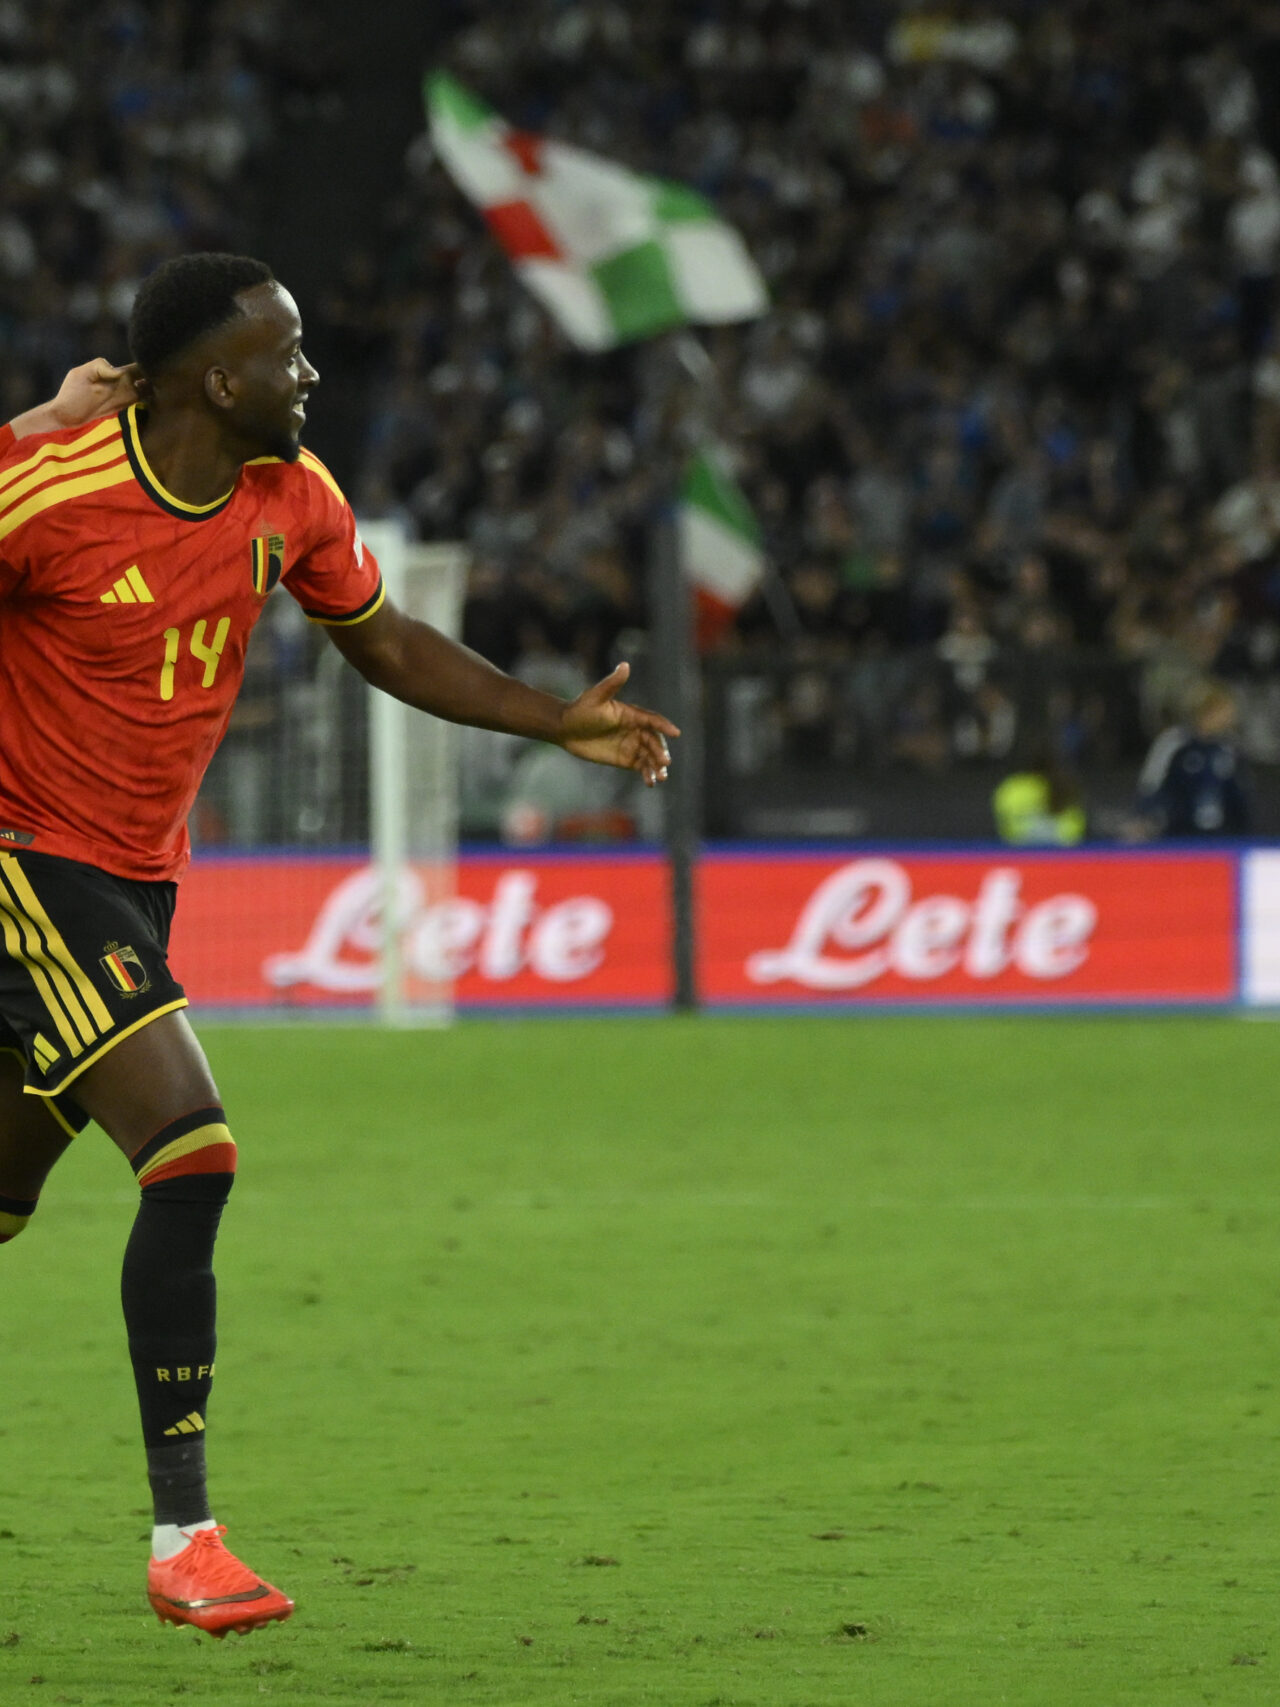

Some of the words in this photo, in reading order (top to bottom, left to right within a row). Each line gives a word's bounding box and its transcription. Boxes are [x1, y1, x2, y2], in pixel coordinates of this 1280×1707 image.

[160, 616, 231, 701] 14
[261, 862, 614, 992] Lete
[745, 857, 1097, 990] Lete
